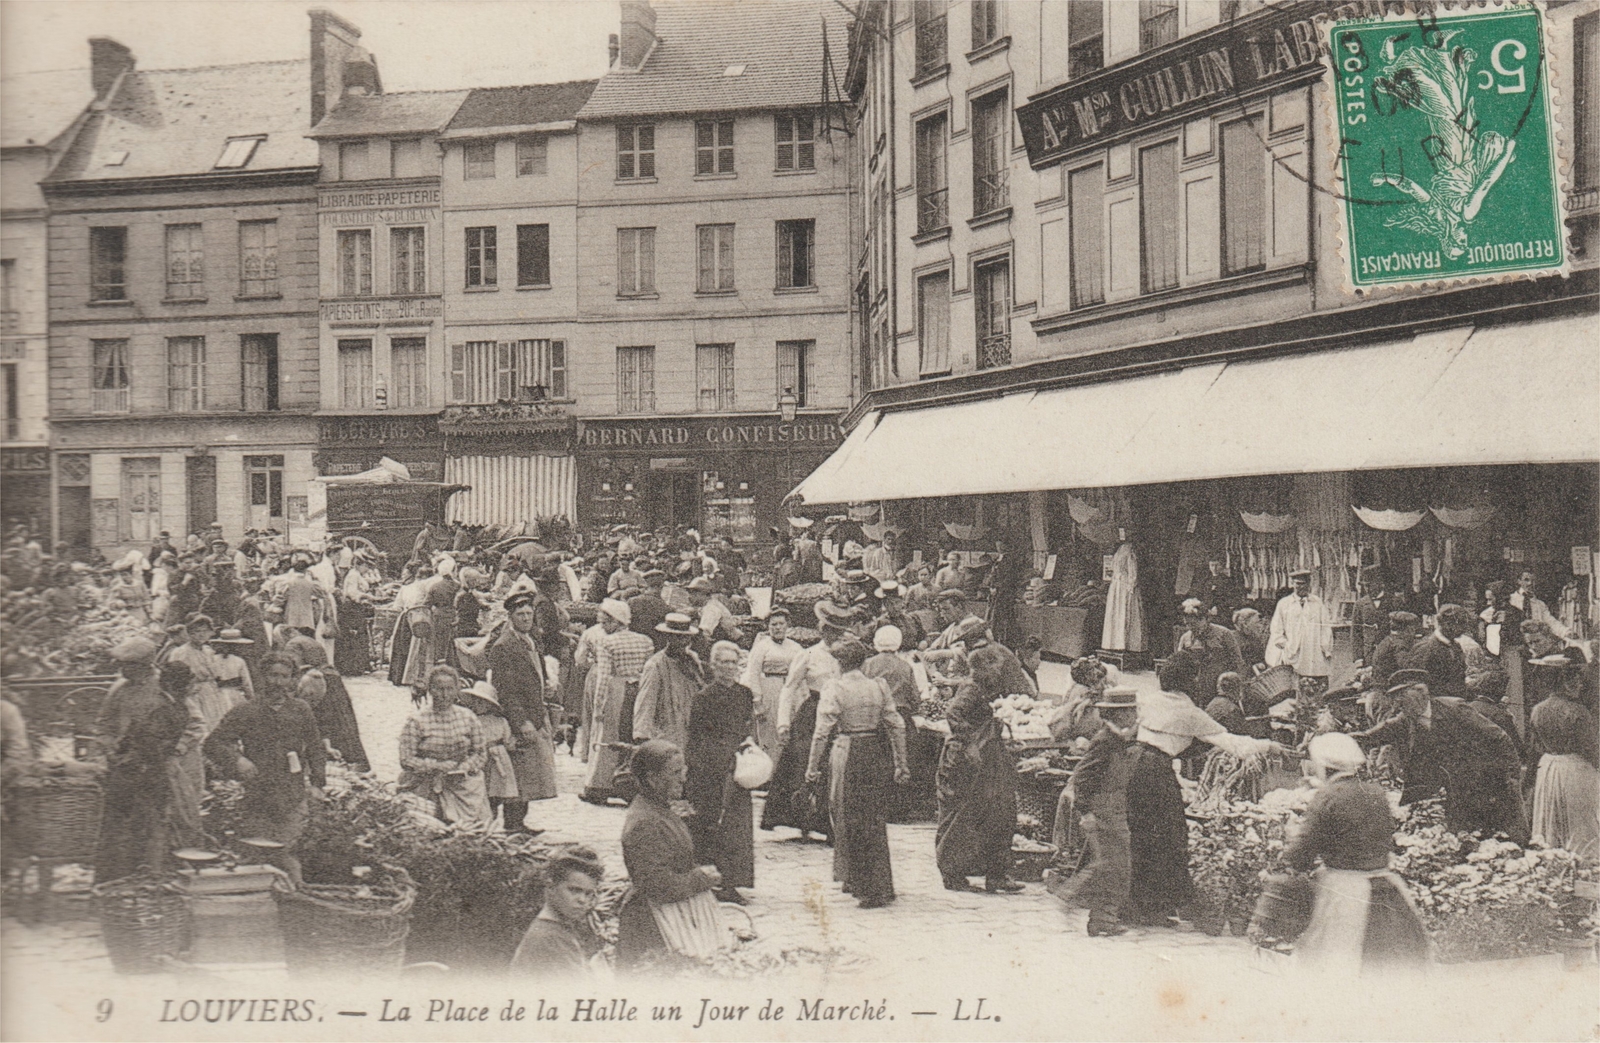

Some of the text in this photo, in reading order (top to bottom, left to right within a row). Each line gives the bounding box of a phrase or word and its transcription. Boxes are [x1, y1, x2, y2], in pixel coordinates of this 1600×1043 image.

[1343, 41, 1367, 126] POSTES
[1361, 249, 1442, 275] FRANÇAISE
[1466, 240, 1555, 265] REPUBLIQUE
[584, 423, 838, 447] BERNARD CONFISEUR
